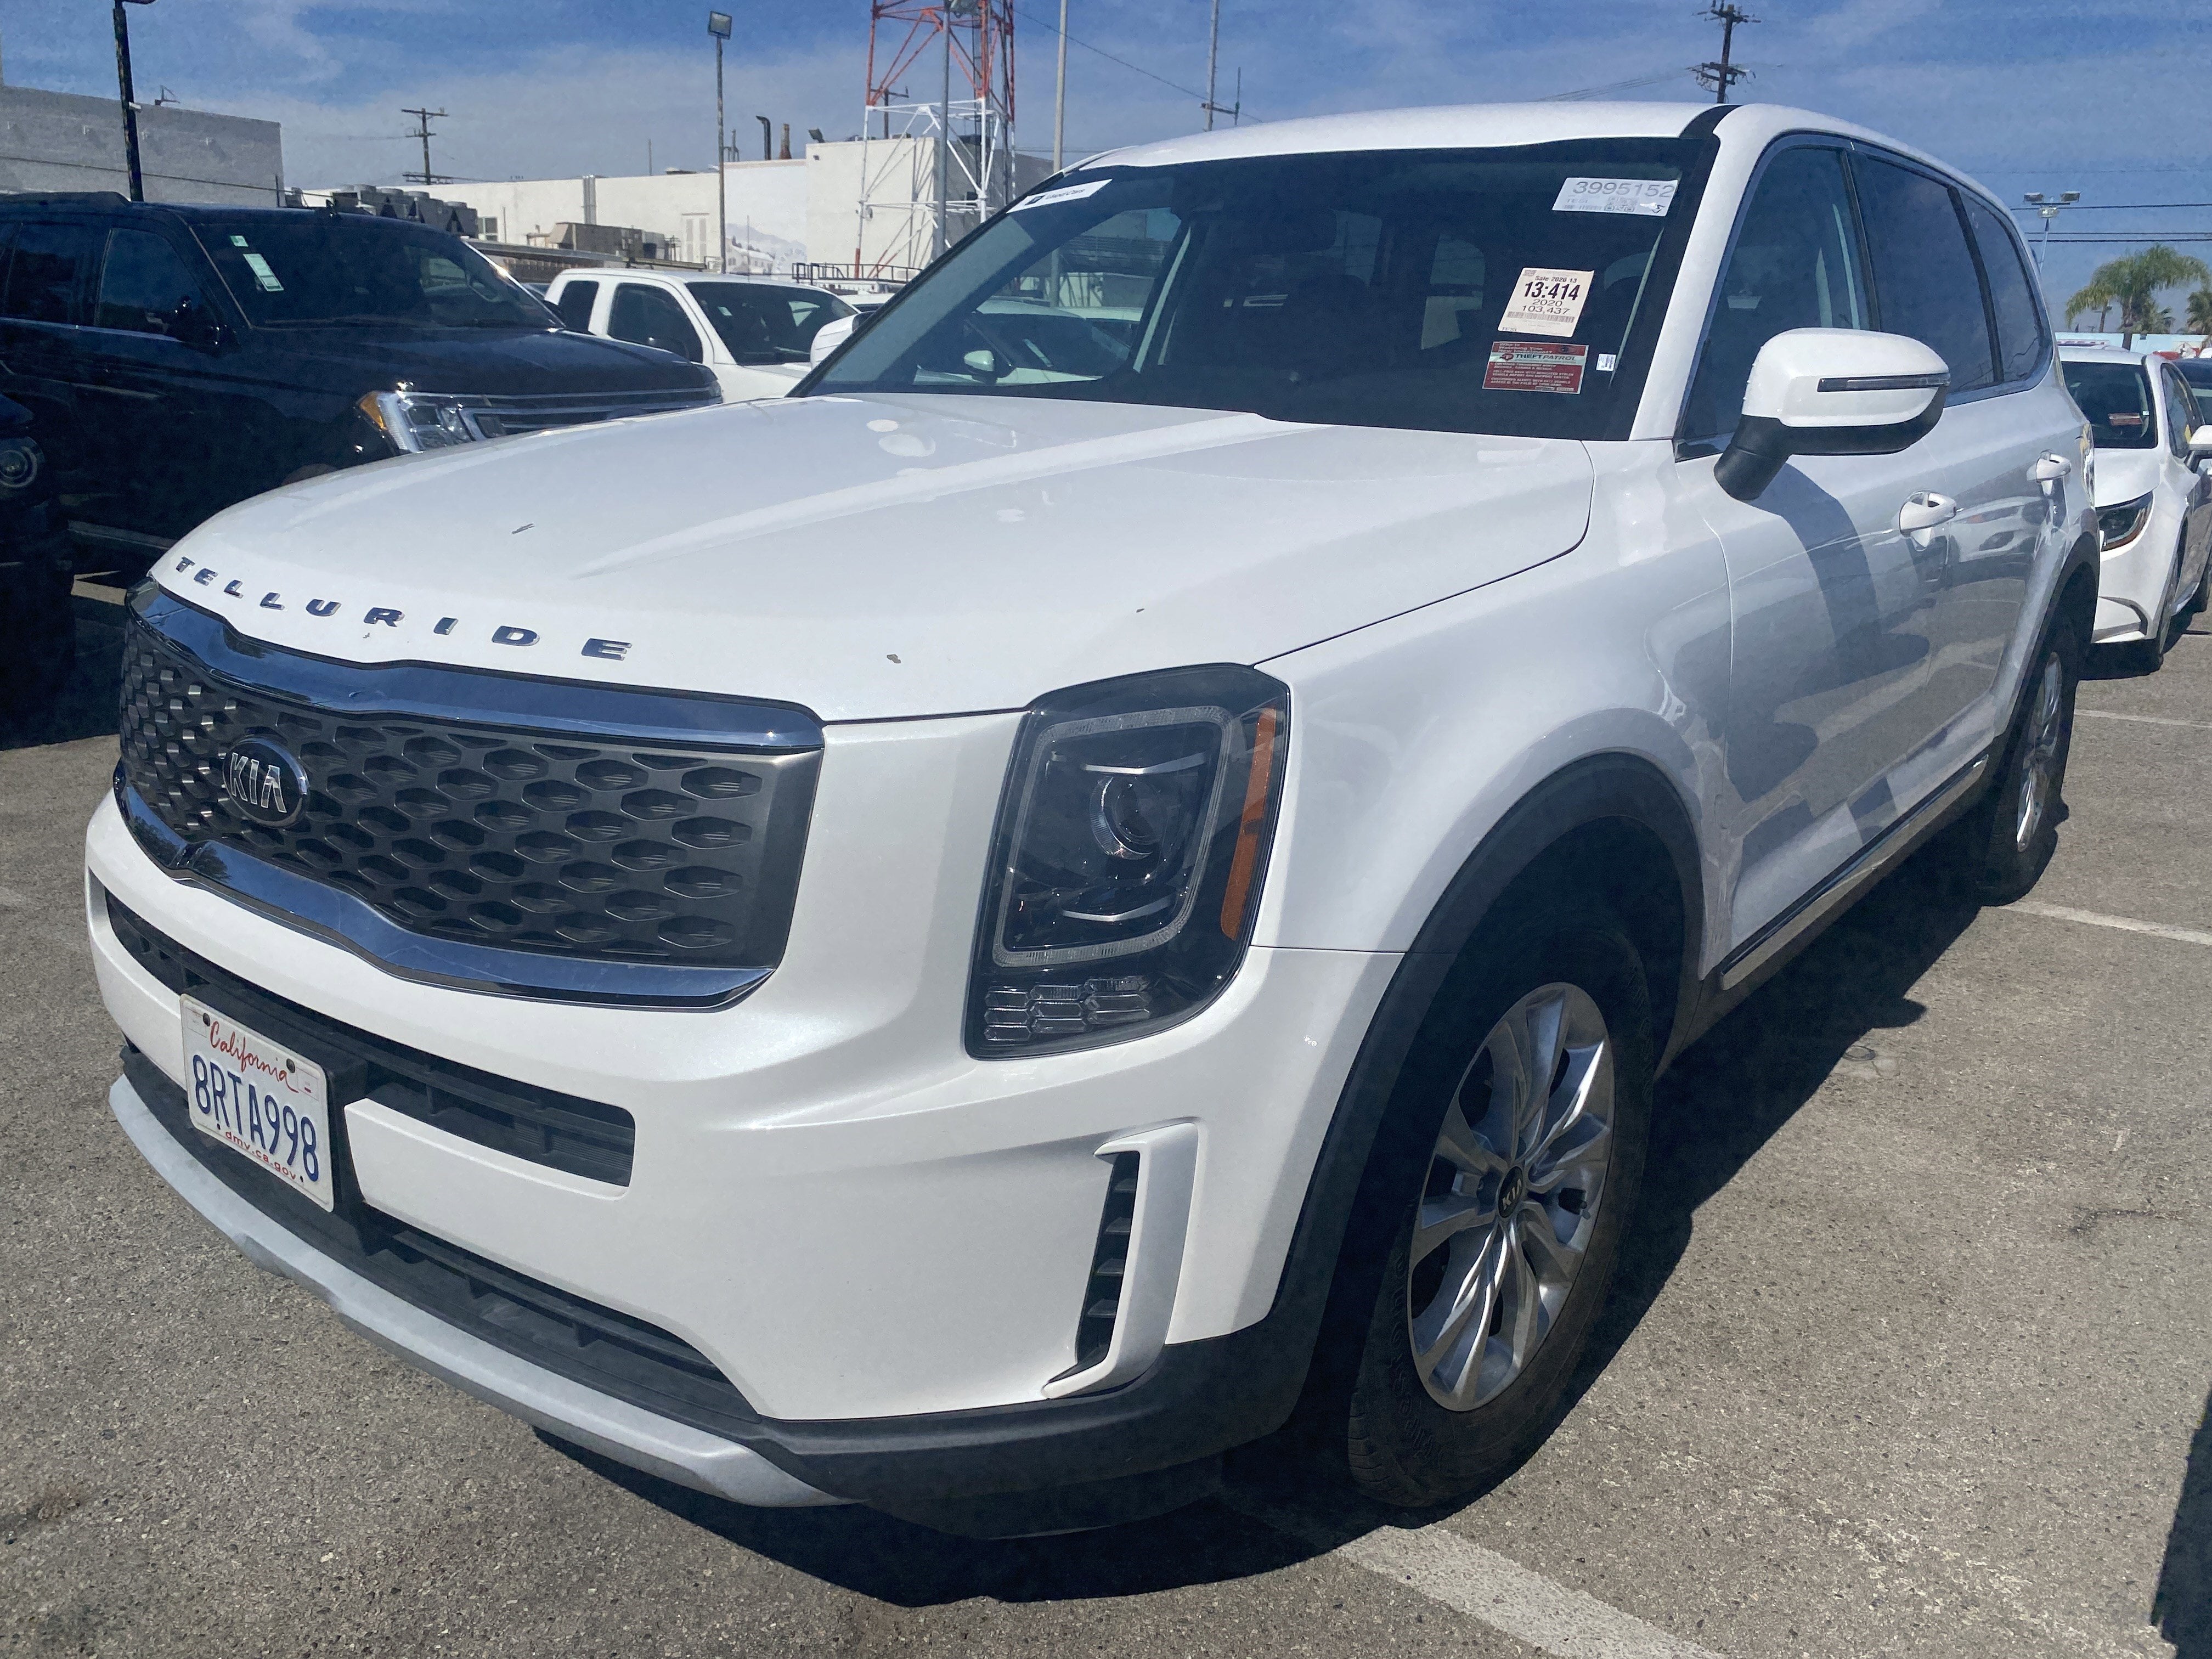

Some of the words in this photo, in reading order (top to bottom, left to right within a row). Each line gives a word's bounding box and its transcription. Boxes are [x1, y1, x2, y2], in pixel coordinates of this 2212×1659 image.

[1572, 181, 1674, 198] 3995152
[1522, 305, 1570, 314] 103,437
[1523, 281, 1581, 301] 13:414
[1532, 299, 1563, 307] 2020
[175, 556, 633, 661] TELLURIDE
[229, 752, 287, 814] KIA
[210, 1021, 299, 1093] California
[193, 1054, 319, 1182] 8RTA998
[225, 1131, 296, 1180] dmv.ca.gov
[1503, 1178, 1522, 1211] KIA
